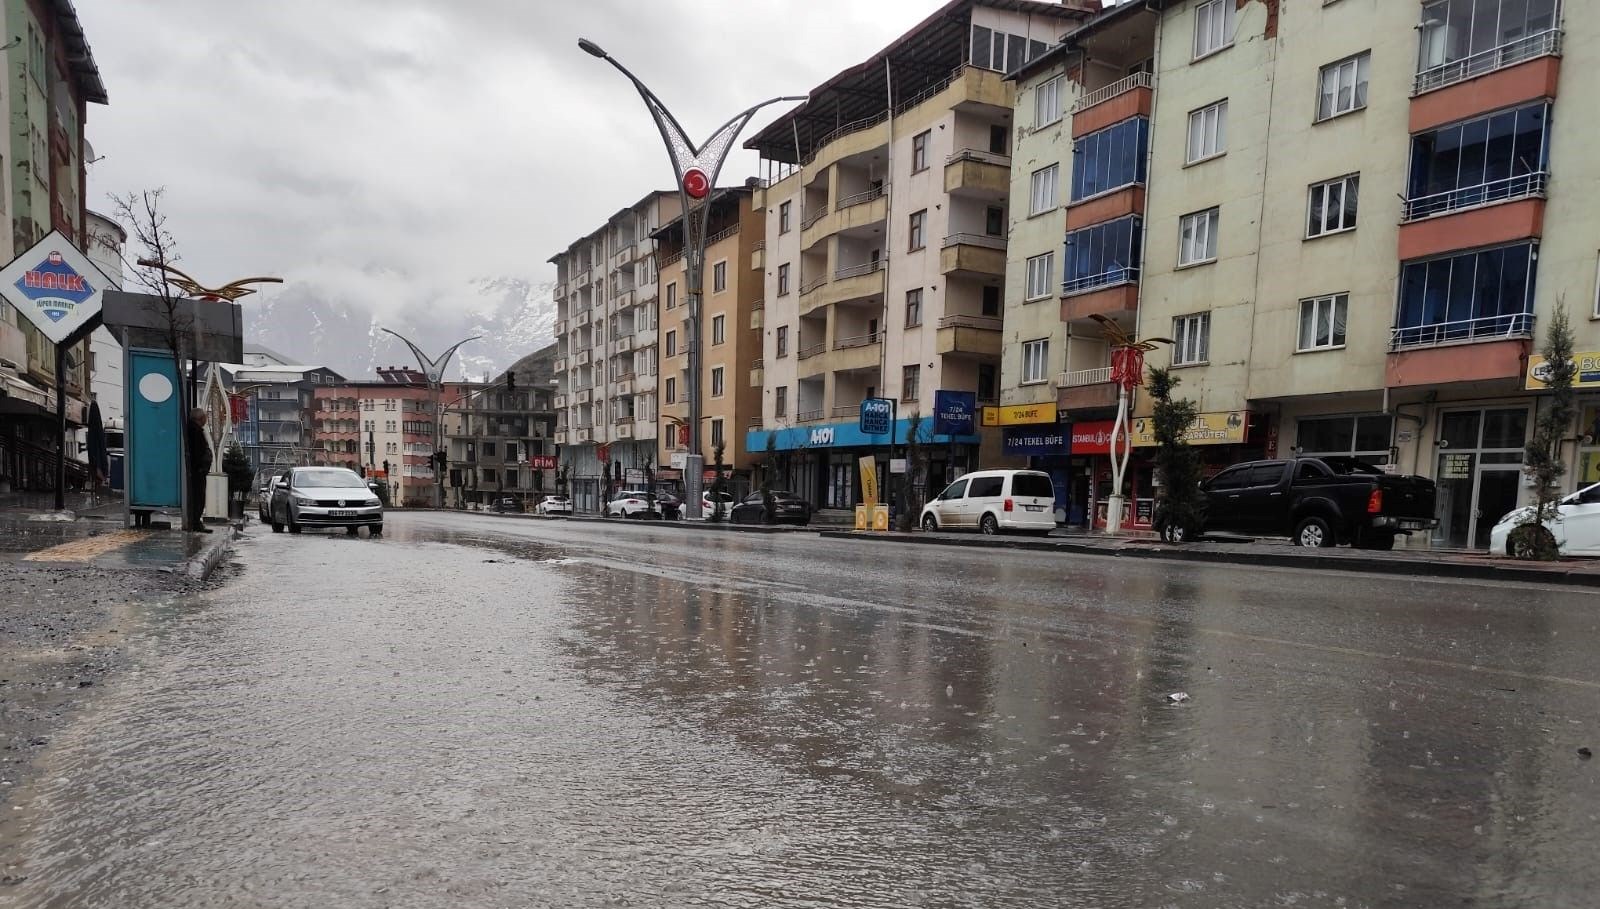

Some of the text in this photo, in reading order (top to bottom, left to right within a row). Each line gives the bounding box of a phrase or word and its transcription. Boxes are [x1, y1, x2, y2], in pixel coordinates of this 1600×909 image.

[25, 271, 85, 291] HALK
[53, 300, 75, 310] MARKET
[1007, 434, 1063, 447] 7/24 TEKEL BÜFE
